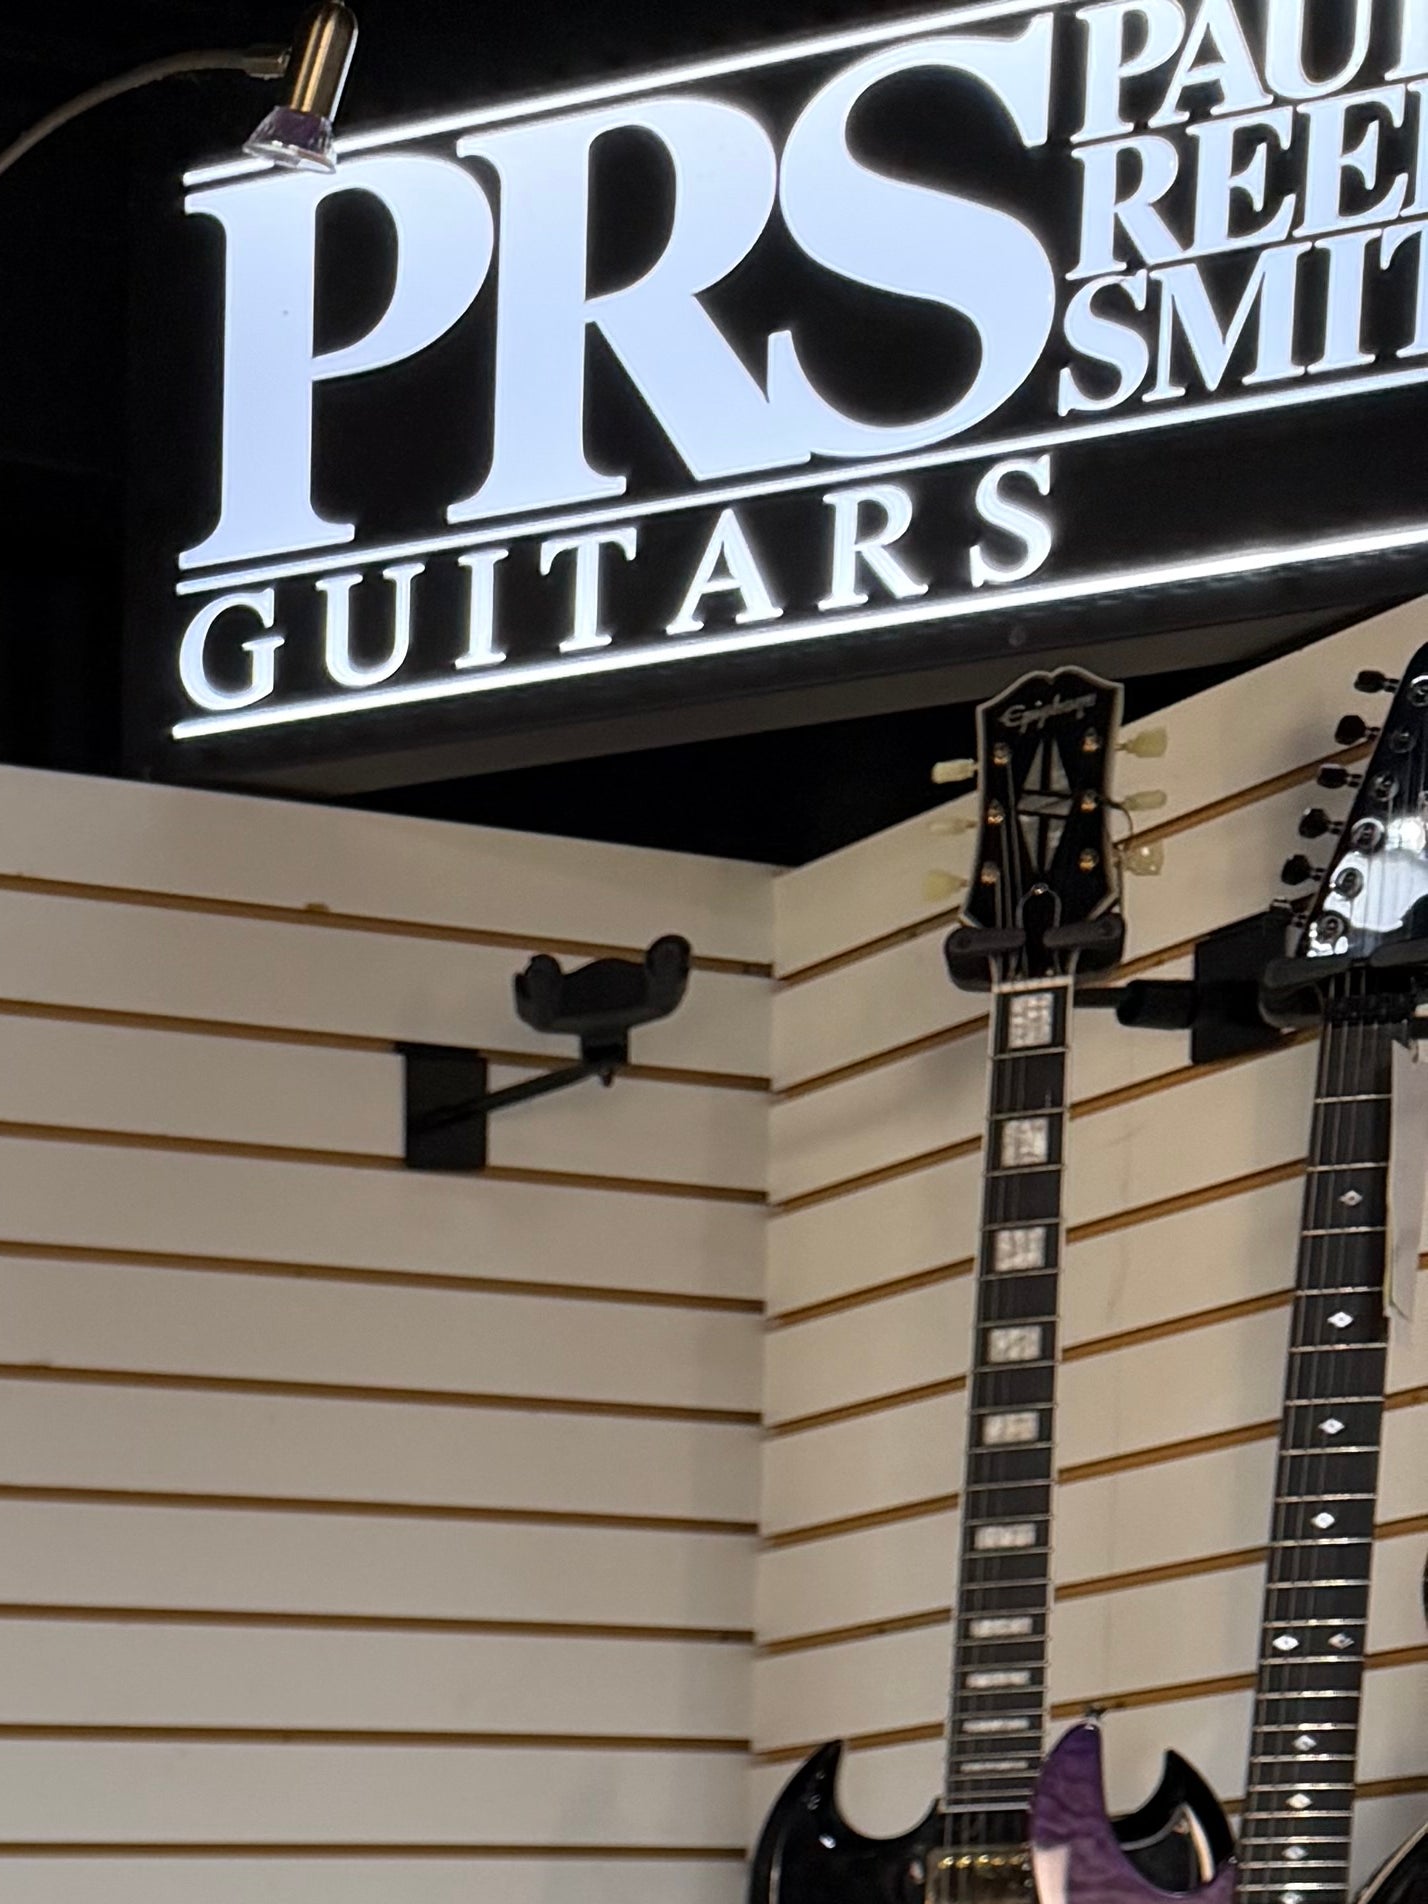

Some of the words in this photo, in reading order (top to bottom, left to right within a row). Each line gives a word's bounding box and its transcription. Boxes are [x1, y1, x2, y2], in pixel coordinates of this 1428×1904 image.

[178, 12, 1055, 570] PRS
[1065, 82, 1428, 281] REE
[178, 456, 1057, 711] GUITARS
